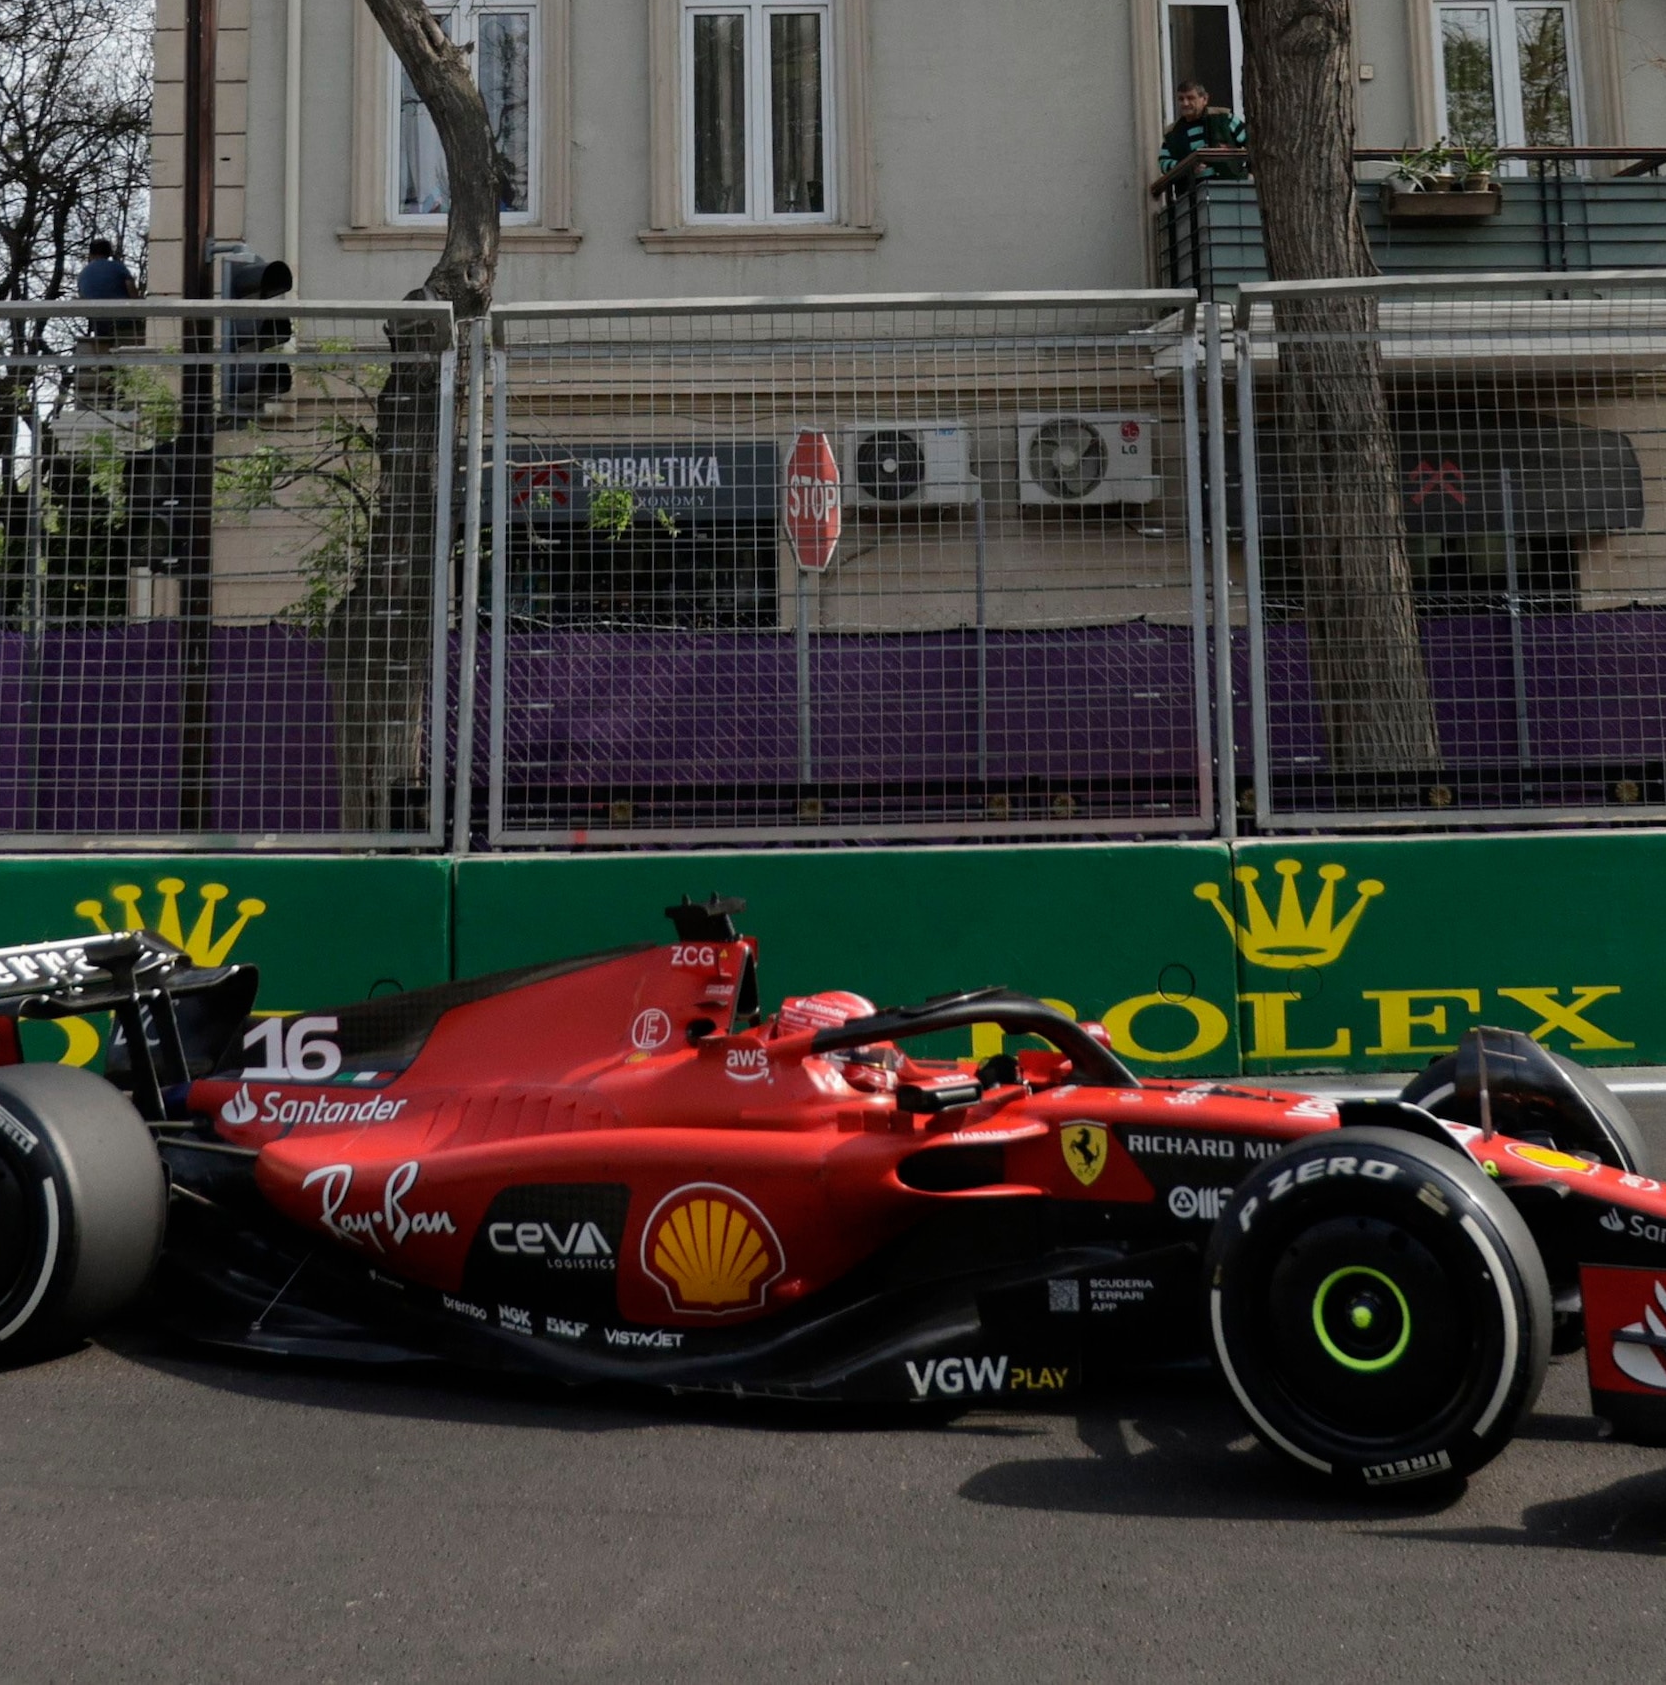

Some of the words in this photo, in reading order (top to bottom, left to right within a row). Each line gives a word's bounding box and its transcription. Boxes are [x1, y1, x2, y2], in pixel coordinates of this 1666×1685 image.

[1121, 444, 1138, 455] LG
[583, 456, 721, 488] PRIBALTIKA
[789, 474, 837, 522] STOP
[240, 1016, 342, 1081] 16
[726, 1049, 768, 1067] aws
[261, 1090, 408, 1124] Santander
[1128, 1133, 1235, 1158] RICHARD
[1239, 1196, 1258, 1233] P
[1267, 1156, 1402, 1202] ZERO
[546, 1258, 616, 1269] LOGISTICS
[1089, 1278, 1154, 1289] SCUDERIA
[1090, 1290, 1144, 1301] FERRARI
[443, 1293, 487, 1321] brembo
[497, 1303, 532, 1327] NGK
[1091, 1302, 1118, 1312] APP
[546, 1316, 589, 1338] SKF
[905, 1355, 1009, 1397] VGW
[1010, 1367, 1069, 1390] PLAY
[1362, 1449, 1453, 1486] PIRELLI
